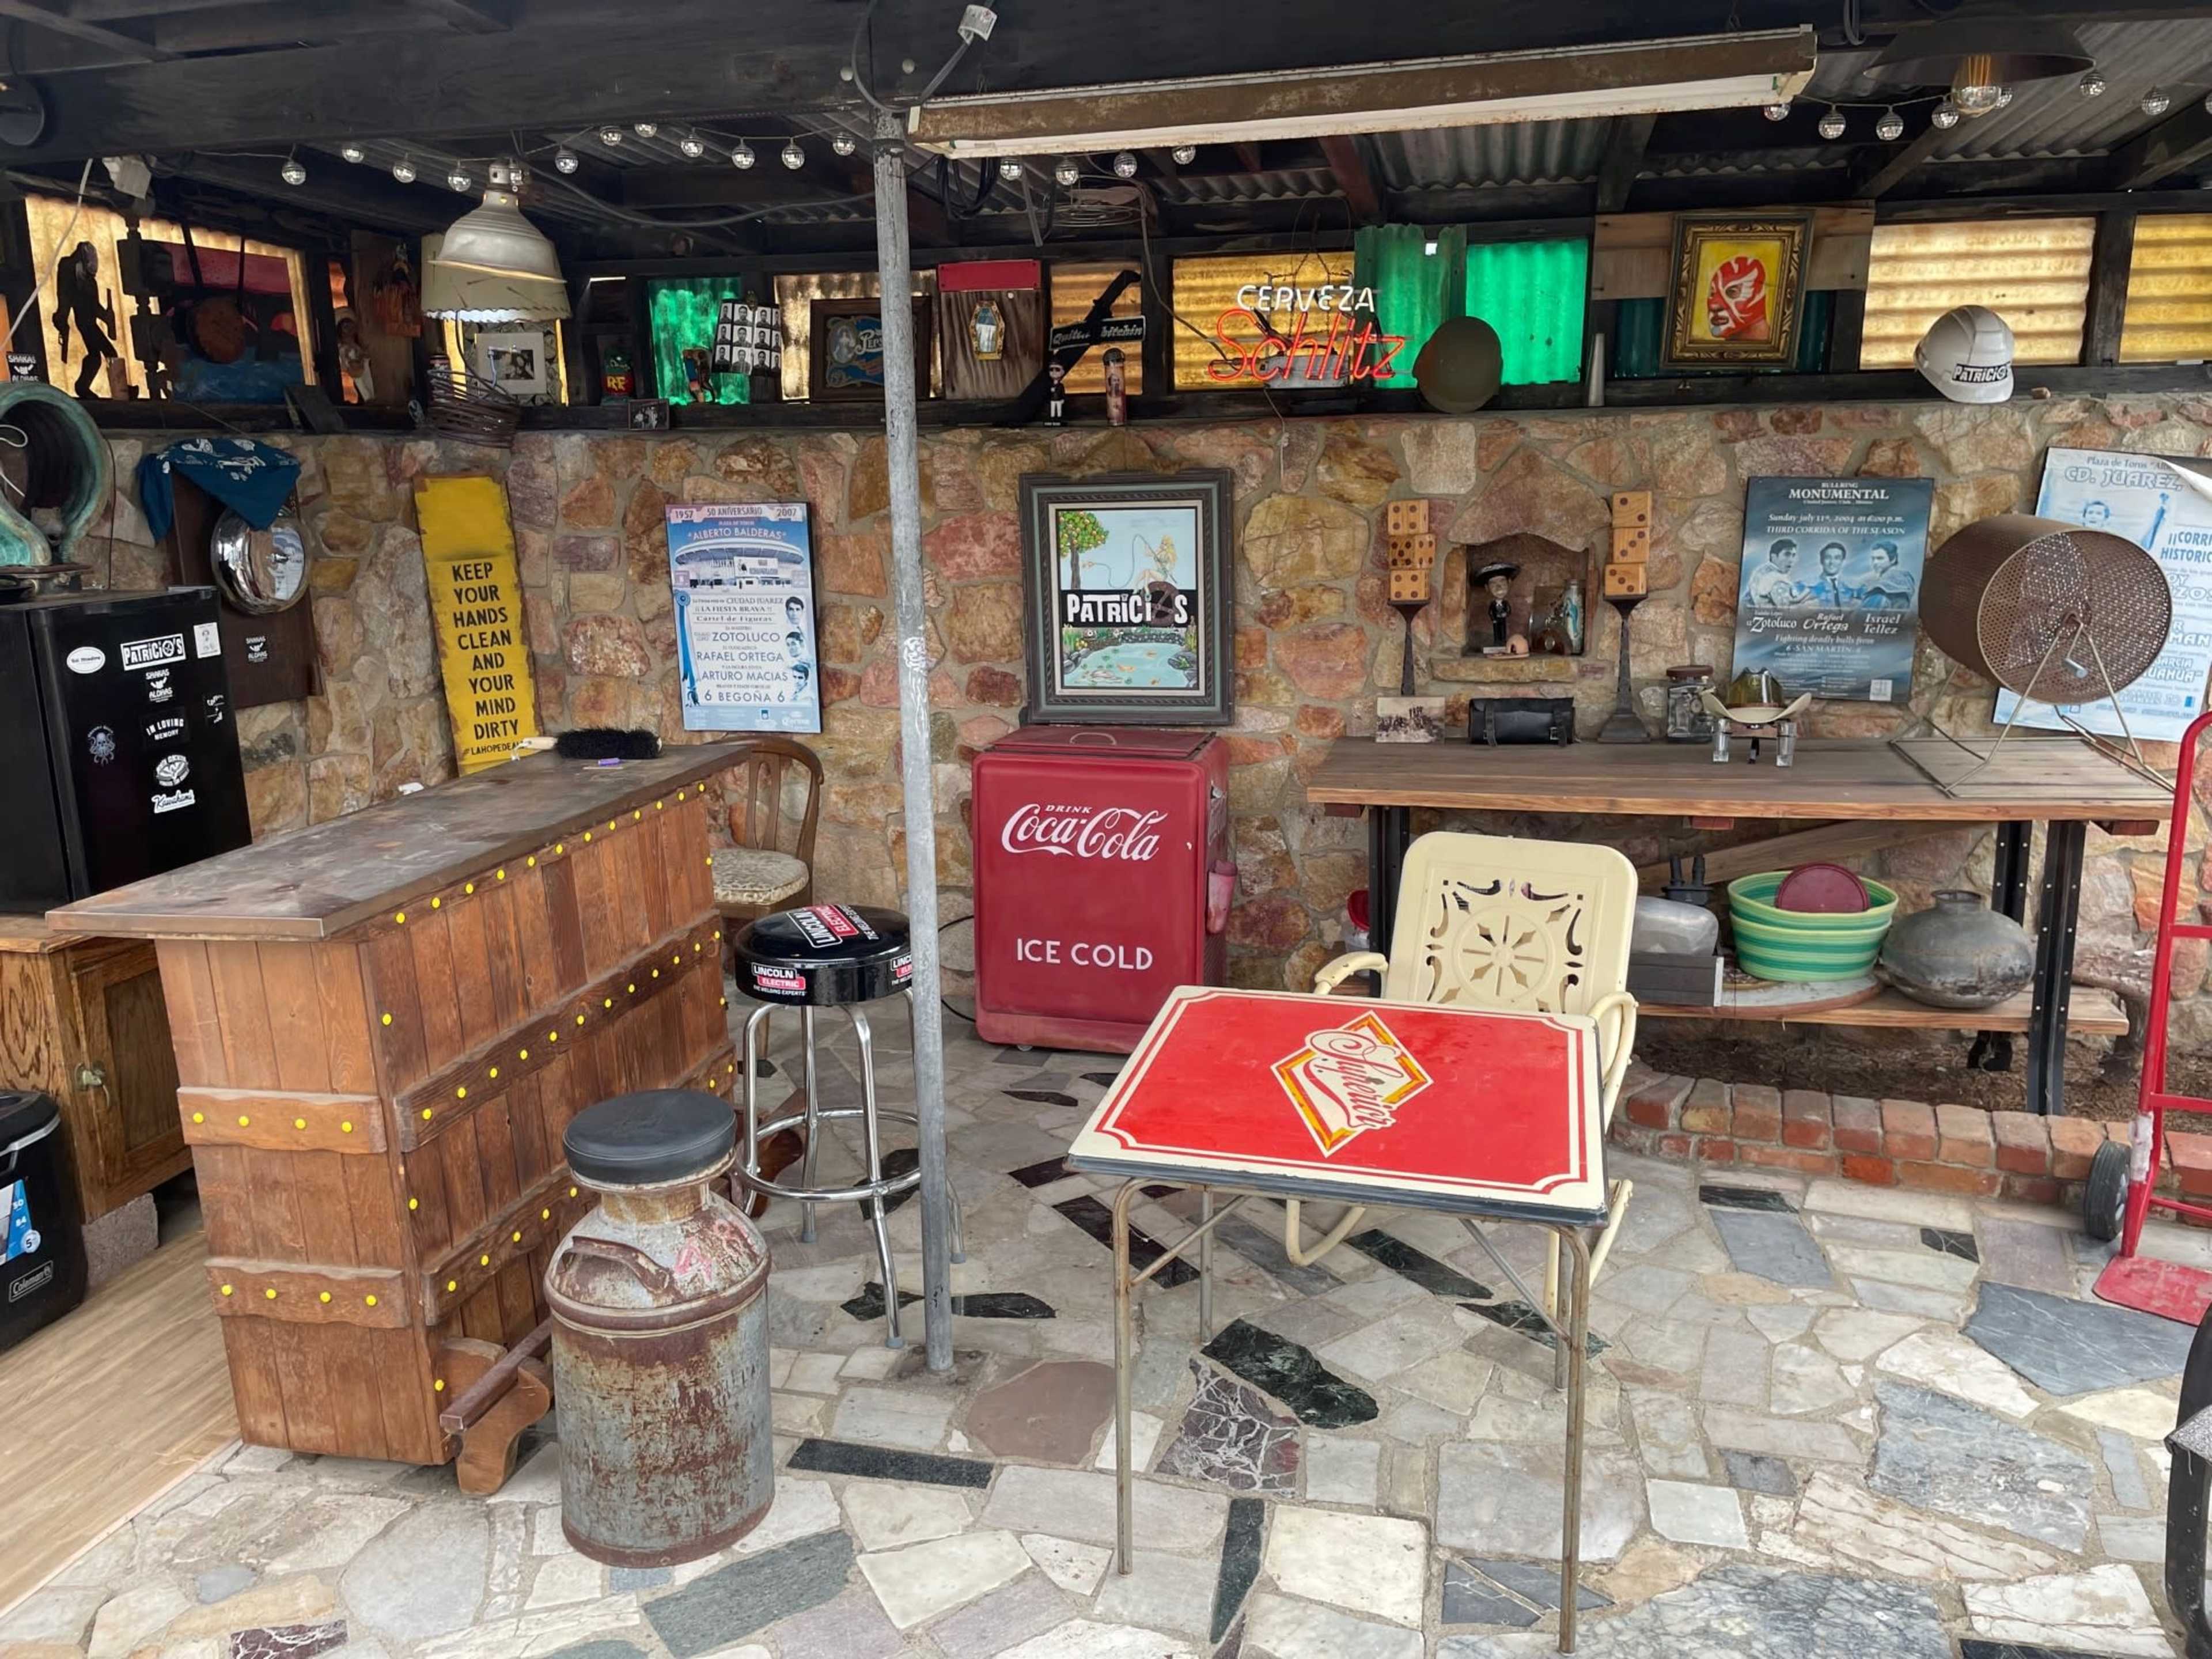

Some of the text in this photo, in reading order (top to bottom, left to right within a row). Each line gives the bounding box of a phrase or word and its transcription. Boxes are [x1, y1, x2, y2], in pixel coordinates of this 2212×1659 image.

[1237, 285, 1375, 313] CERVEZA
[1207, 308, 1405, 381] Schlitz
[2065, 466, 2096, 483] CD.
[1788, 488, 1889, 499] MONUMENTAL
[675, 510, 694, 519] 1957
[707, 507, 716, 517] 50
[777, 508, 797, 517] 2007
[1768, 513, 1797, 522] Sunday
[1795, 525, 1836, 534] CORRIDA
[452, 562, 493, 582] KEEP
[454, 585, 500, 604] YOUR
[453, 607, 508, 628] HANDS
[1816, 613, 1844, 621] Rafael
[1865, 613, 1901, 624] Israel
[1802, 619, 1849, 633] Ortega
[1863, 623, 1898, 634] Tellez
[457, 630, 512, 650] CLEAN
[712, 632, 780, 642] ZOTOLUCO
[472, 653, 504, 671] AND
[696, 652, 784, 661] RAFAEL ORTEGA
[702, 671, 743, 680] ARTURO
[469, 674, 514, 694] YOUR
[704, 690, 711, 701] 6
[778, 691, 785, 702] 6
[476, 697, 515, 717] MIND
[157, 718, 184, 730] LOVING
[474, 719, 518, 740] DIRTY
[1044, 804, 1092, 814] DRINK
[1001, 803, 1168, 861] Coca-Cola
[1016, 938, 1153, 970] ICE COLD
[753, 965, 794, 979] LINCOLN
[762, 978, 800, 987] ELECTRIC
[13, 1271, 44, 1294] Coleman
